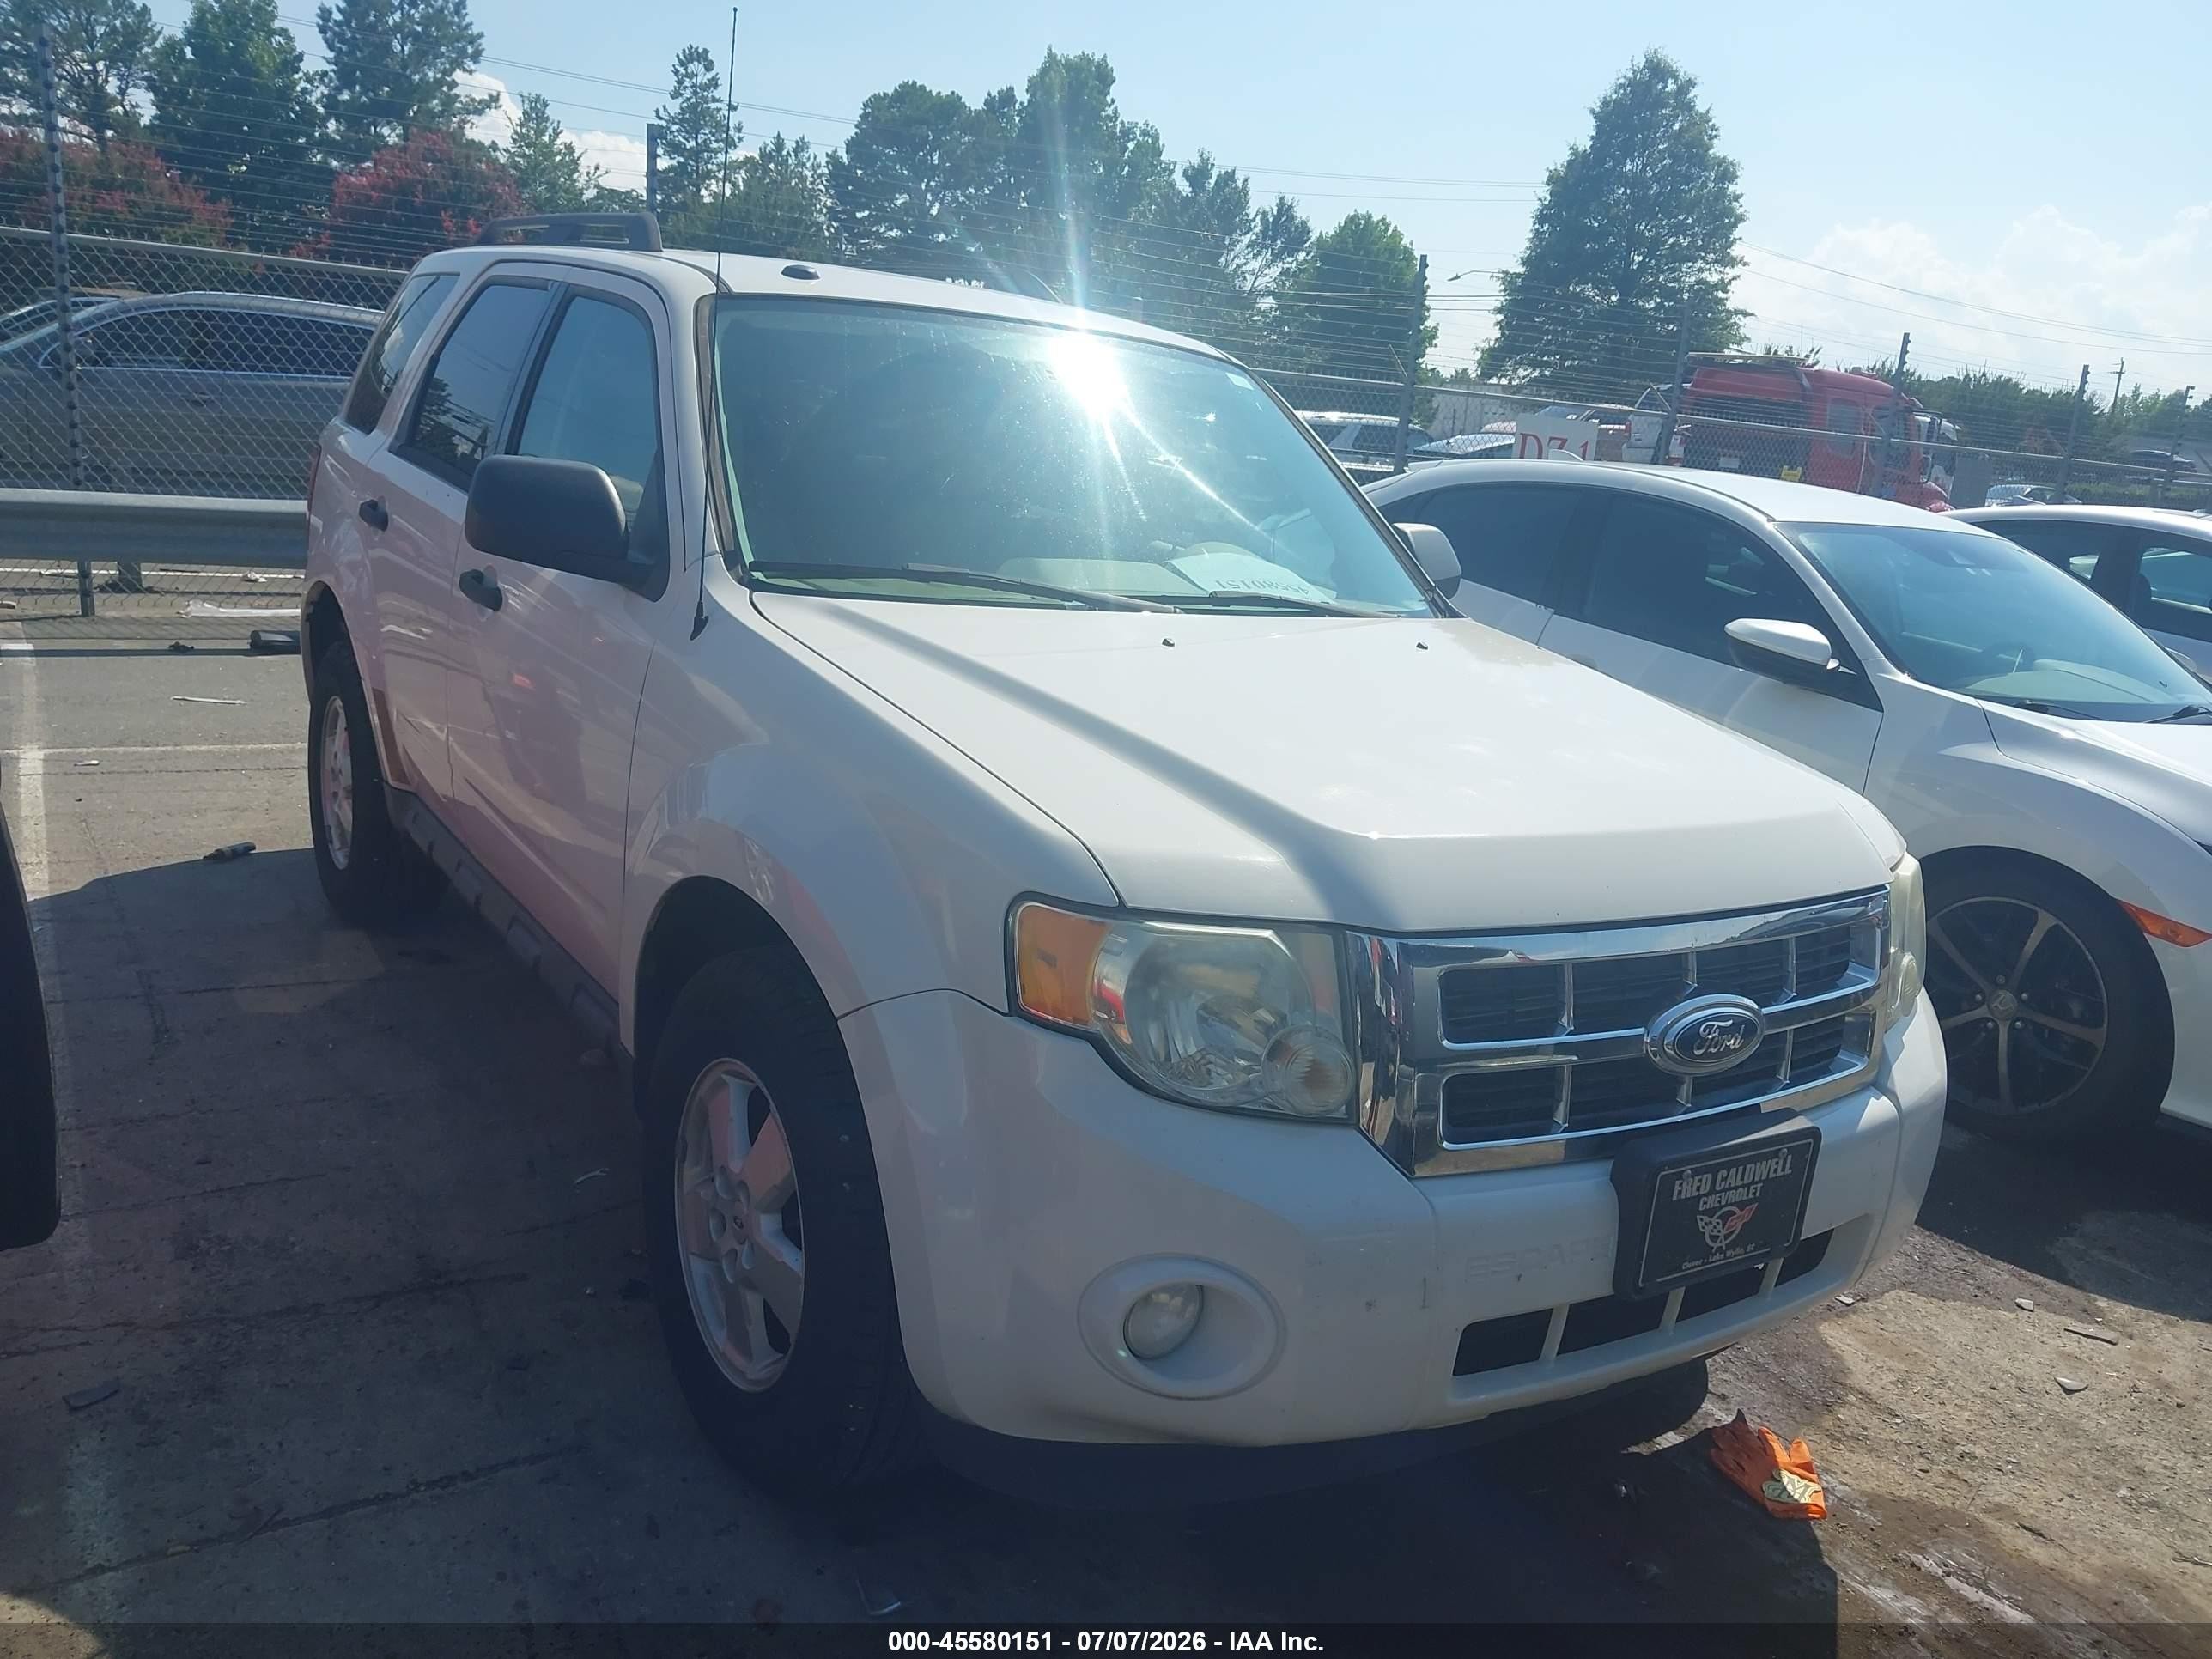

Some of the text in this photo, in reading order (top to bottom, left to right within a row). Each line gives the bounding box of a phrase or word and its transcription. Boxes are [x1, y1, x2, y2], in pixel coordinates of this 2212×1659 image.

[1693, 1018, 1746, 1056] Ford
[1672, 1154, 1792, 1201] FRED CALDWELL
[1698, 1182, 1764, 1211] CHEVROLET
